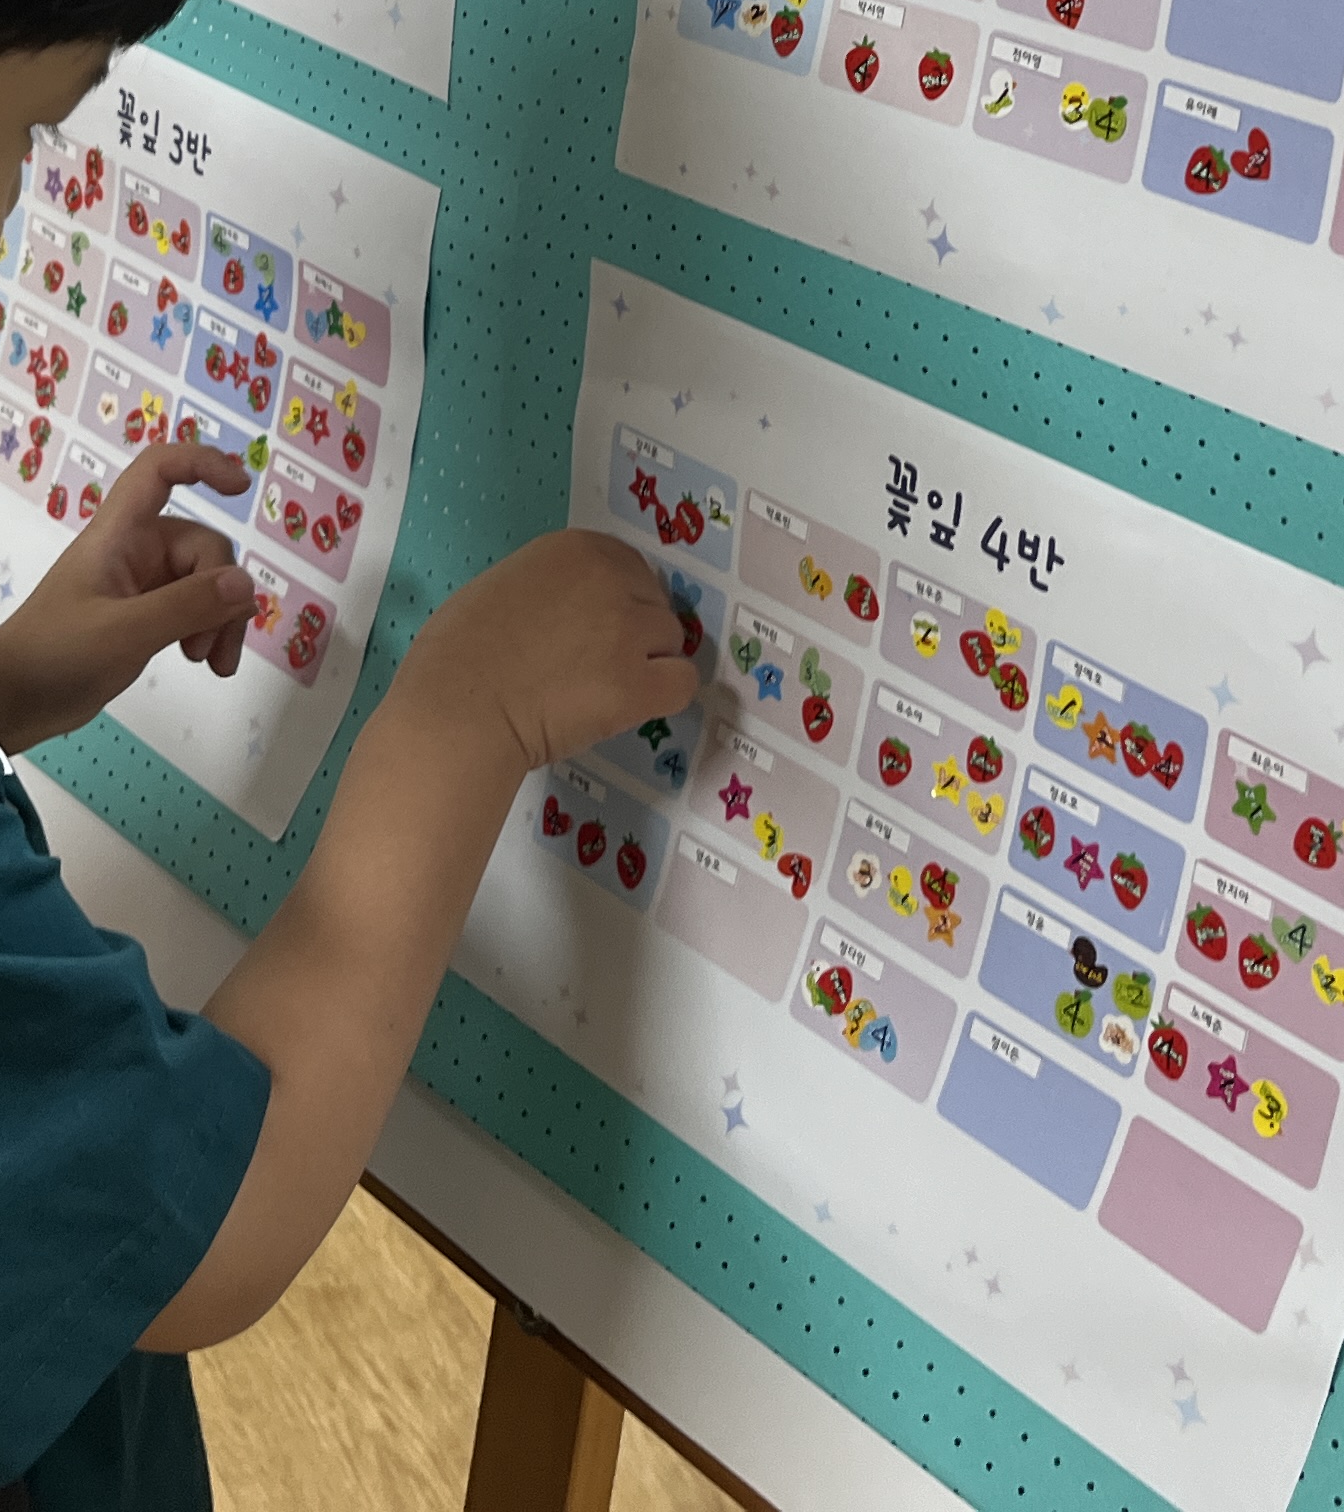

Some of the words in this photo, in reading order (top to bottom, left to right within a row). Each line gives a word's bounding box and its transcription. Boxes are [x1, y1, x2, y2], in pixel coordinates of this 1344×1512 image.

[117, 88, 160, 155] 꽃잎
[168, 123, 213, 176] 3반
[1096, 109, 1119, 141] 4
[885, 454, 963, 551] 꽃잎
[980, 516, 1066, 593] 4반
[1063, 1001, 1085, 1035] 4
